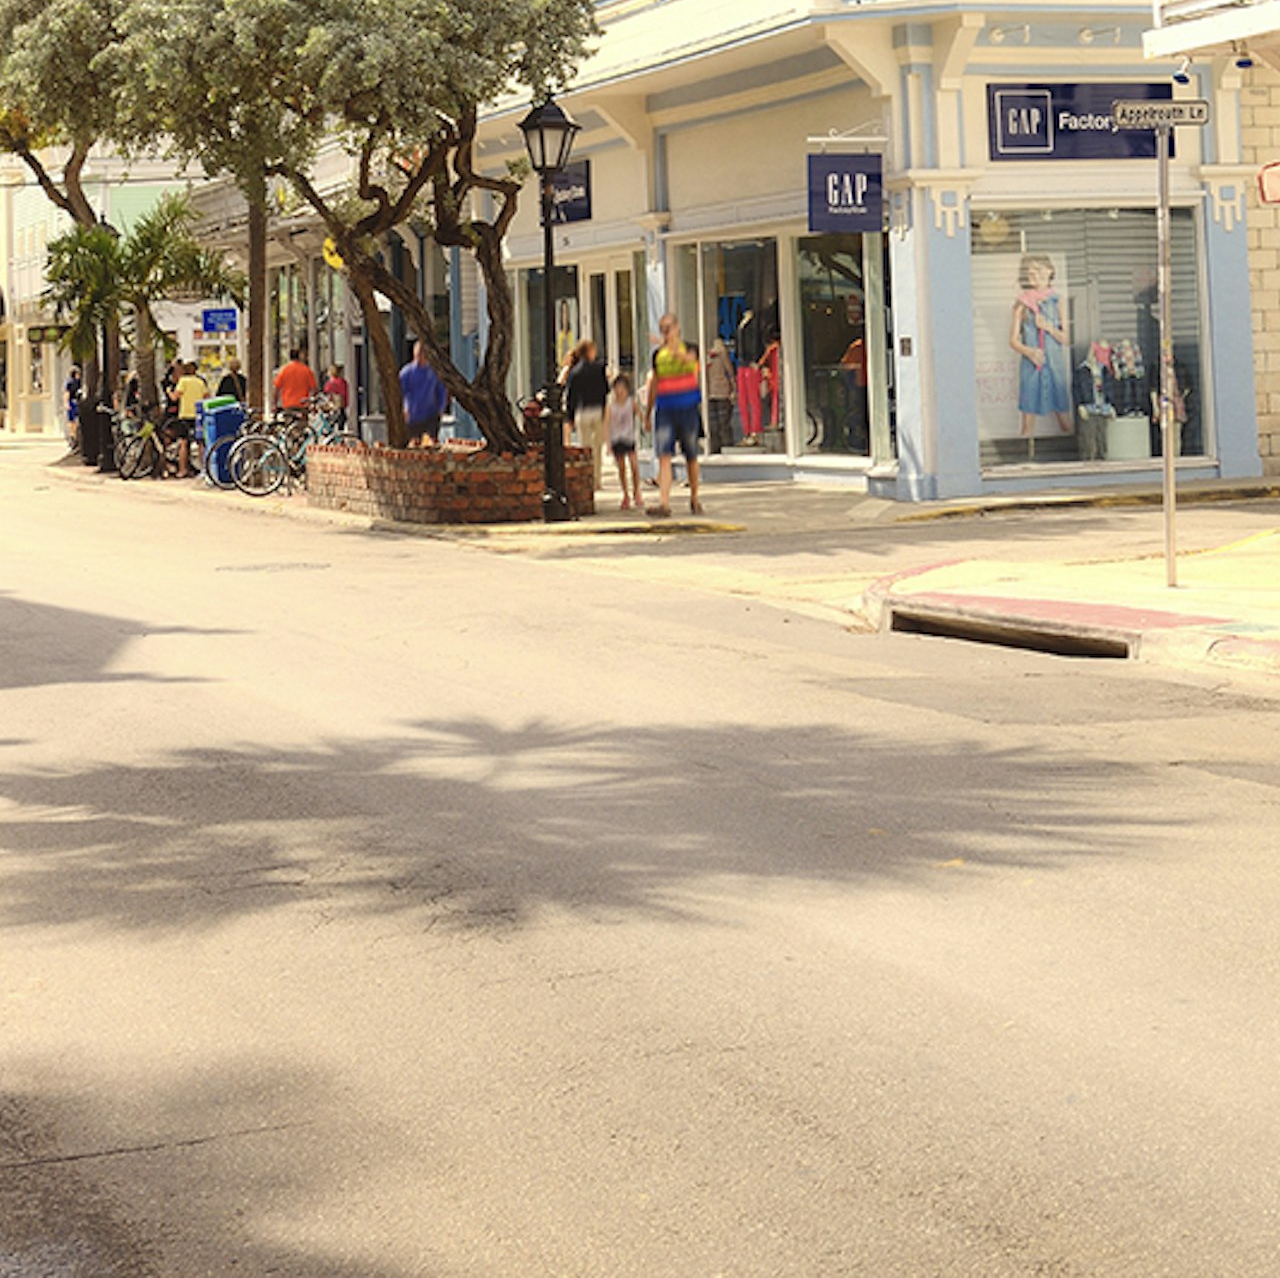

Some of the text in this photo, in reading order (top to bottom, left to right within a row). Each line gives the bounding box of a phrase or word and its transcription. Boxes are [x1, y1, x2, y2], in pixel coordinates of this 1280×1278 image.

[1008, 108, 1120, 136] GAP Factory
[1119, 104, 1205, 122] Appelrouth Ln
[827, 172, 868, 205] GAP
